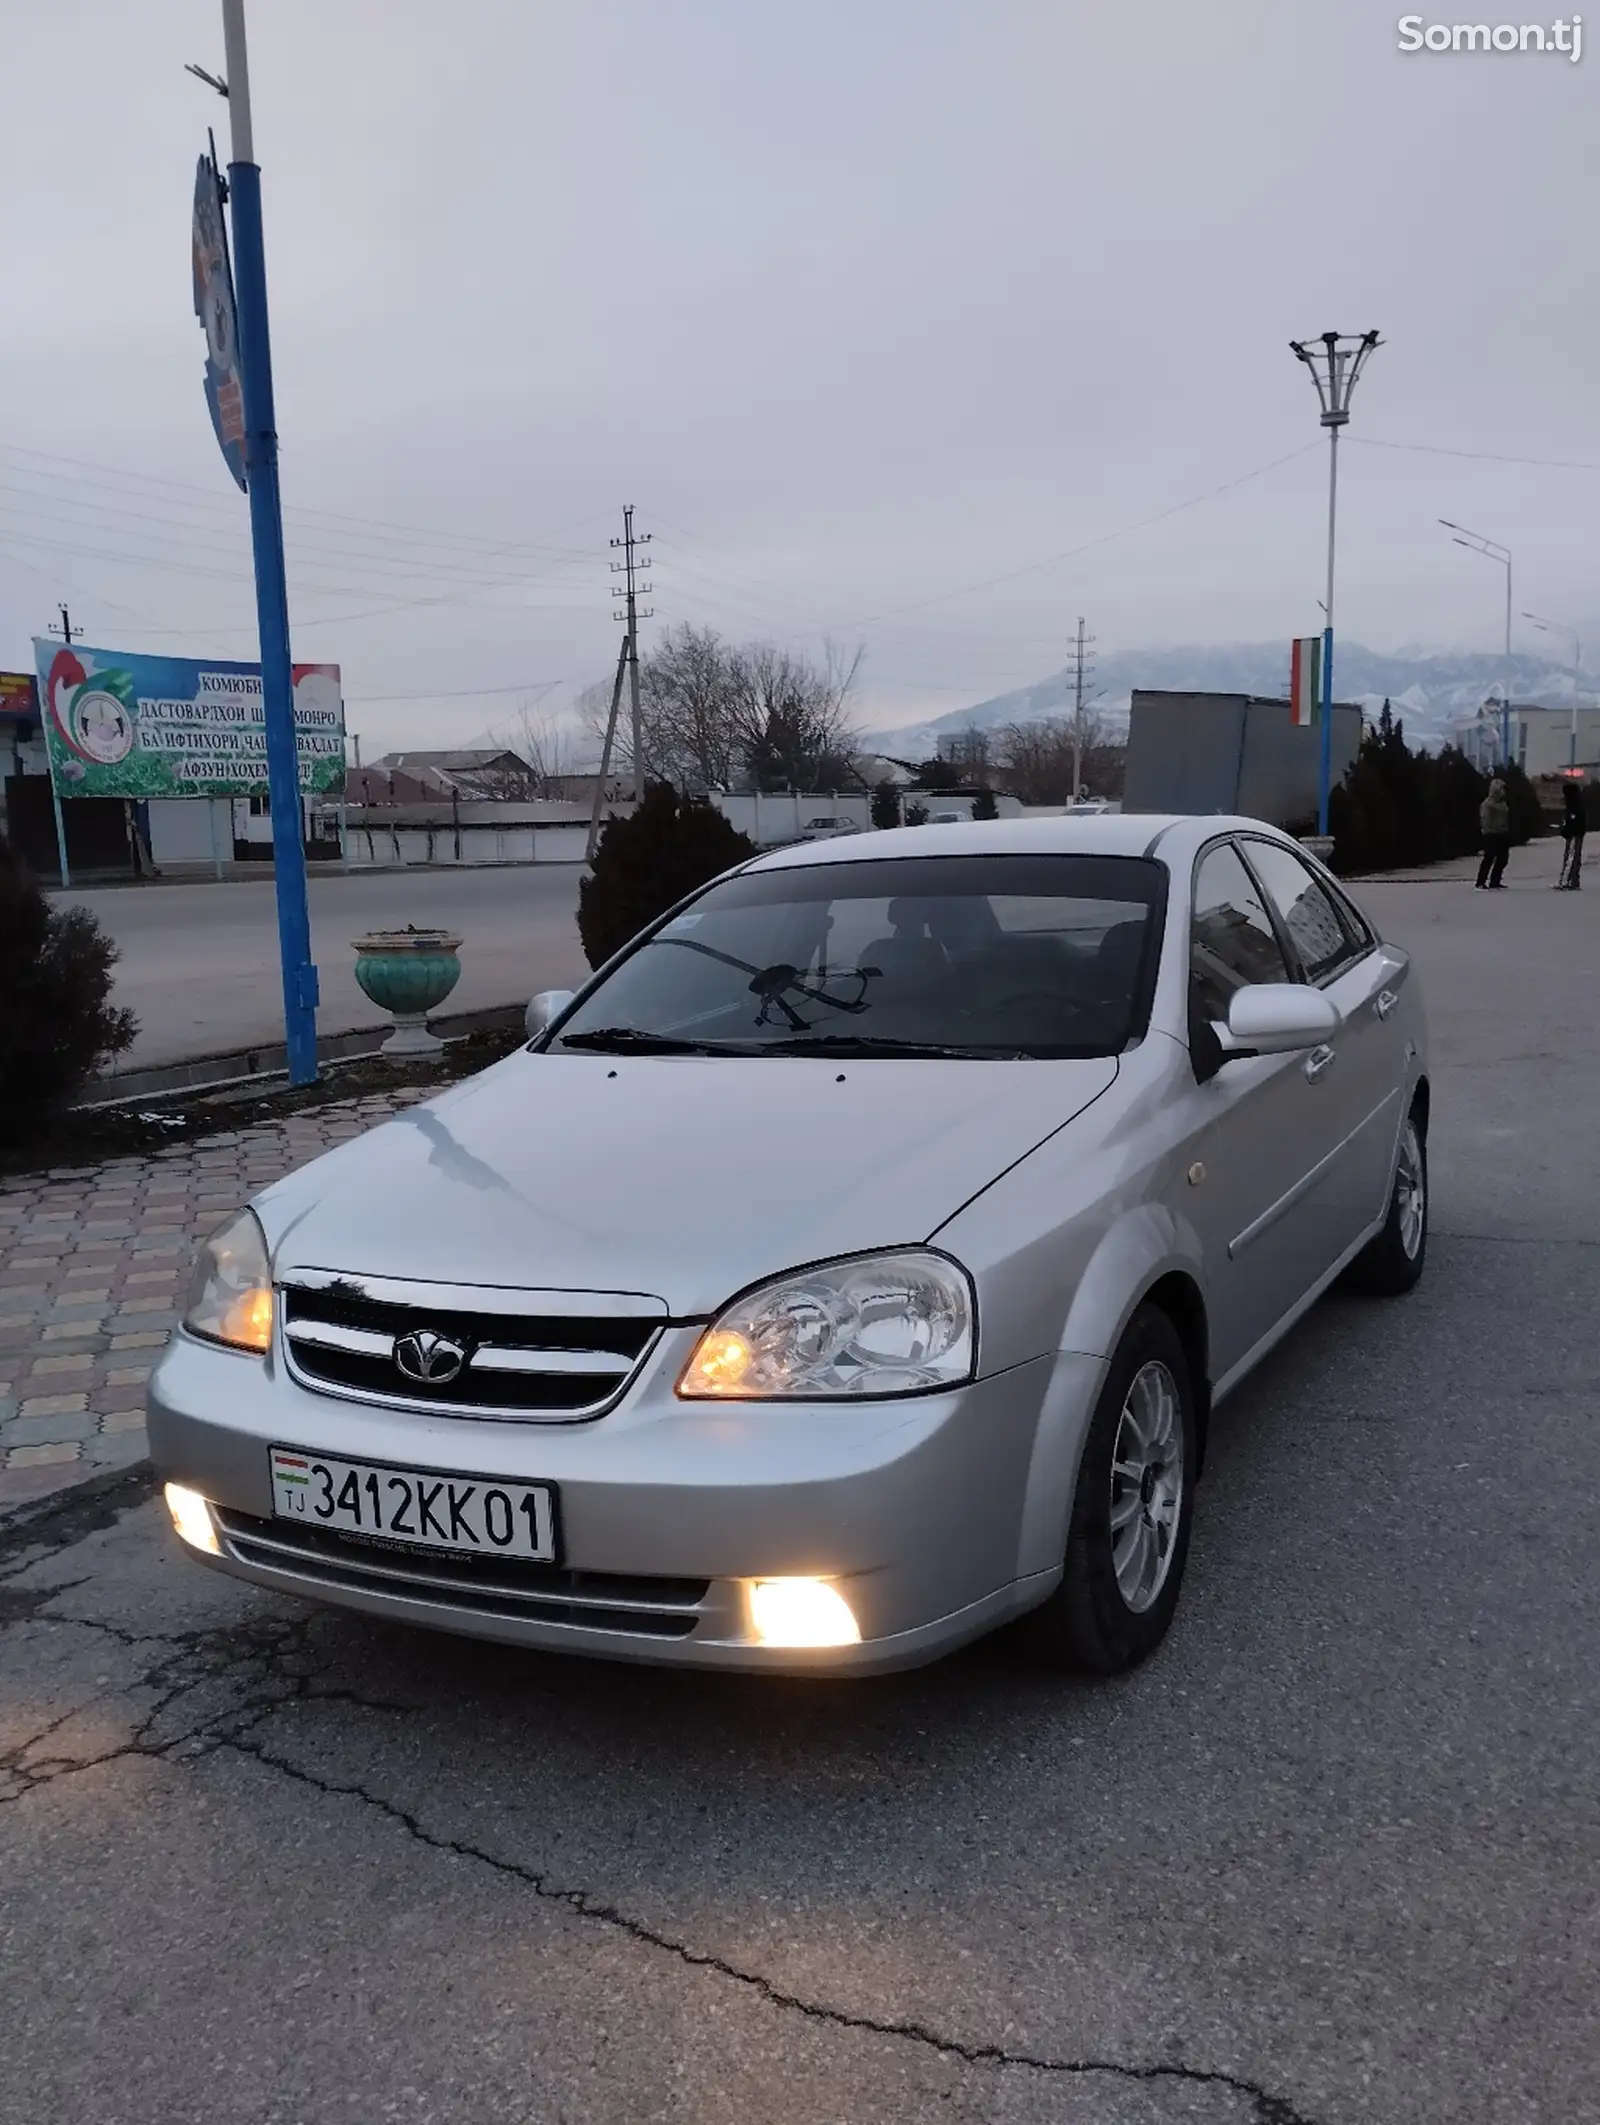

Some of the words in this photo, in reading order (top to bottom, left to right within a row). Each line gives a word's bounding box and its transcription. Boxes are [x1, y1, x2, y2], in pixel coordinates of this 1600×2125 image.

[141, 732, 160, 747] БА
[164, 732, 238, 749] ИФТИХОРИ
[183, 761, 224, 777] АФЗУН
[284, 1490, 305, 1513] TJ
[311, 1464, 539, 1551] 3412KK01
